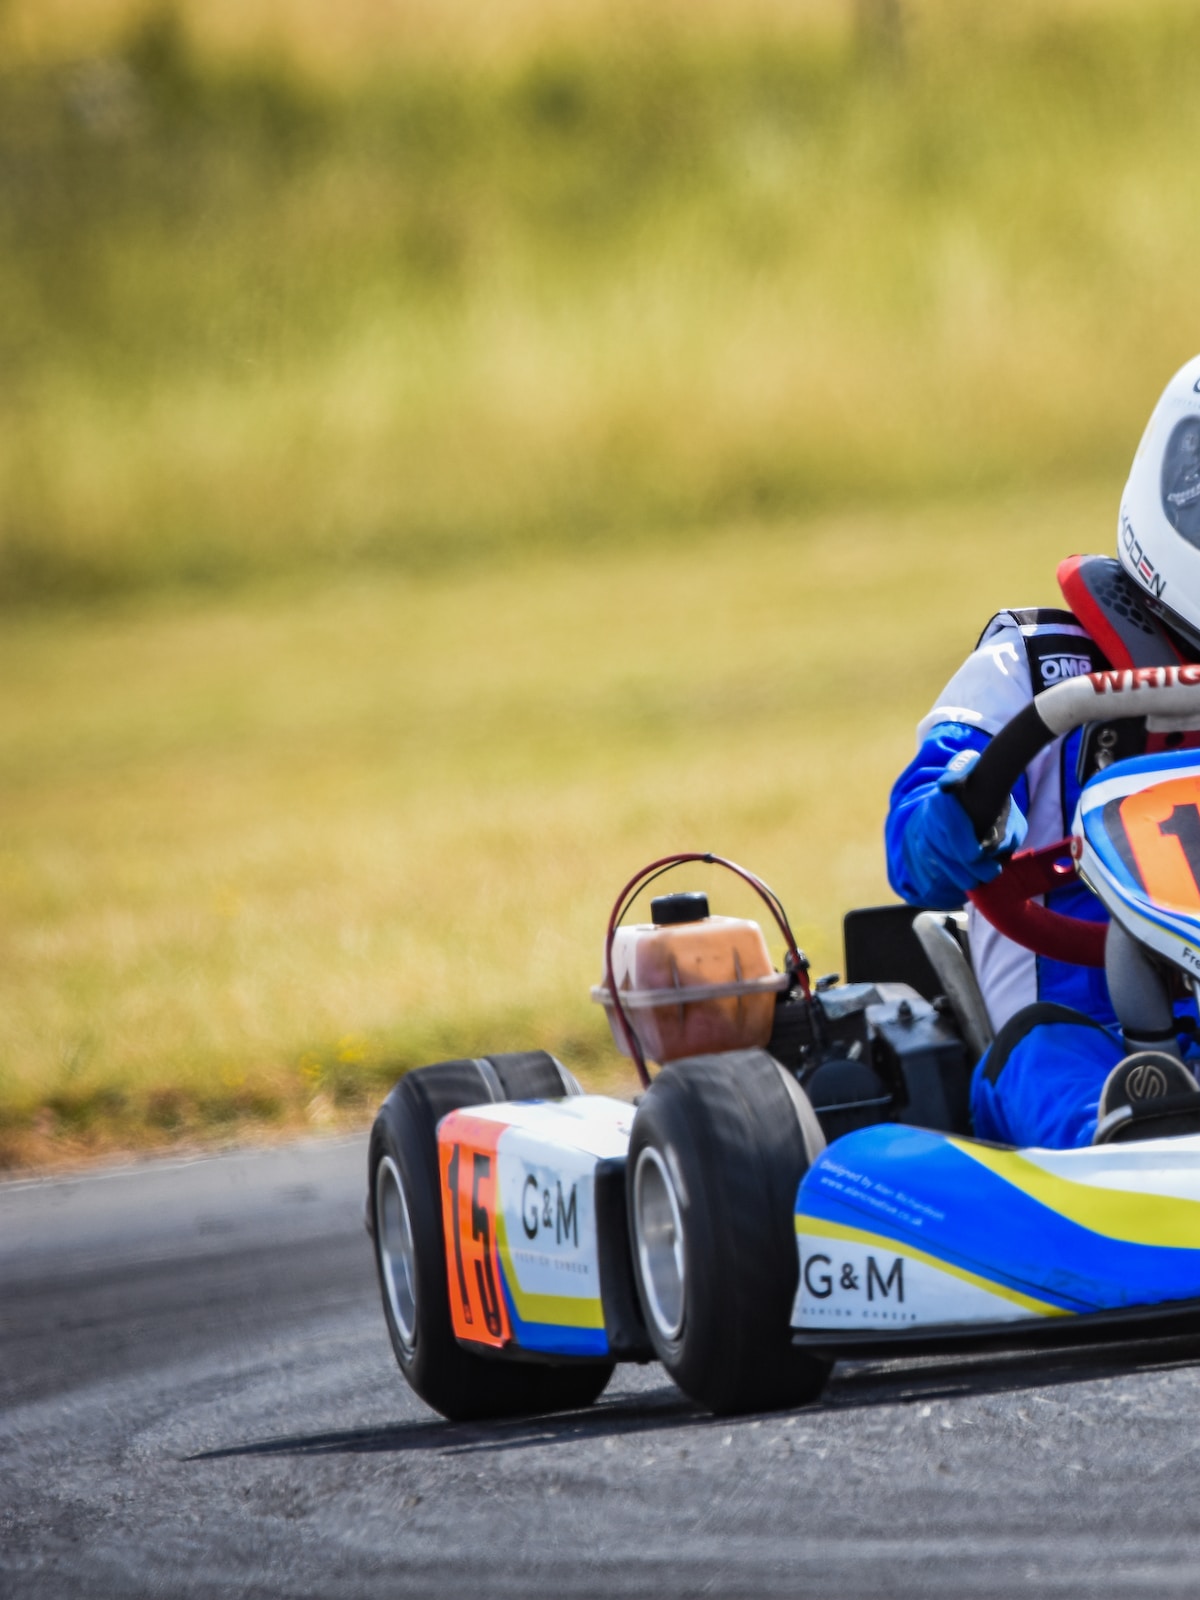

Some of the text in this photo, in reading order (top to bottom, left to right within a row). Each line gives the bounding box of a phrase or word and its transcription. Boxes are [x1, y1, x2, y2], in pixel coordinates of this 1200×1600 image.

[1040, 660, 1092, 681] OMP
[448, 1143, 503, 1337] 15
[522, 1174, 578, 1248] G&M
[804, 1254, 904, 1303] G&M
